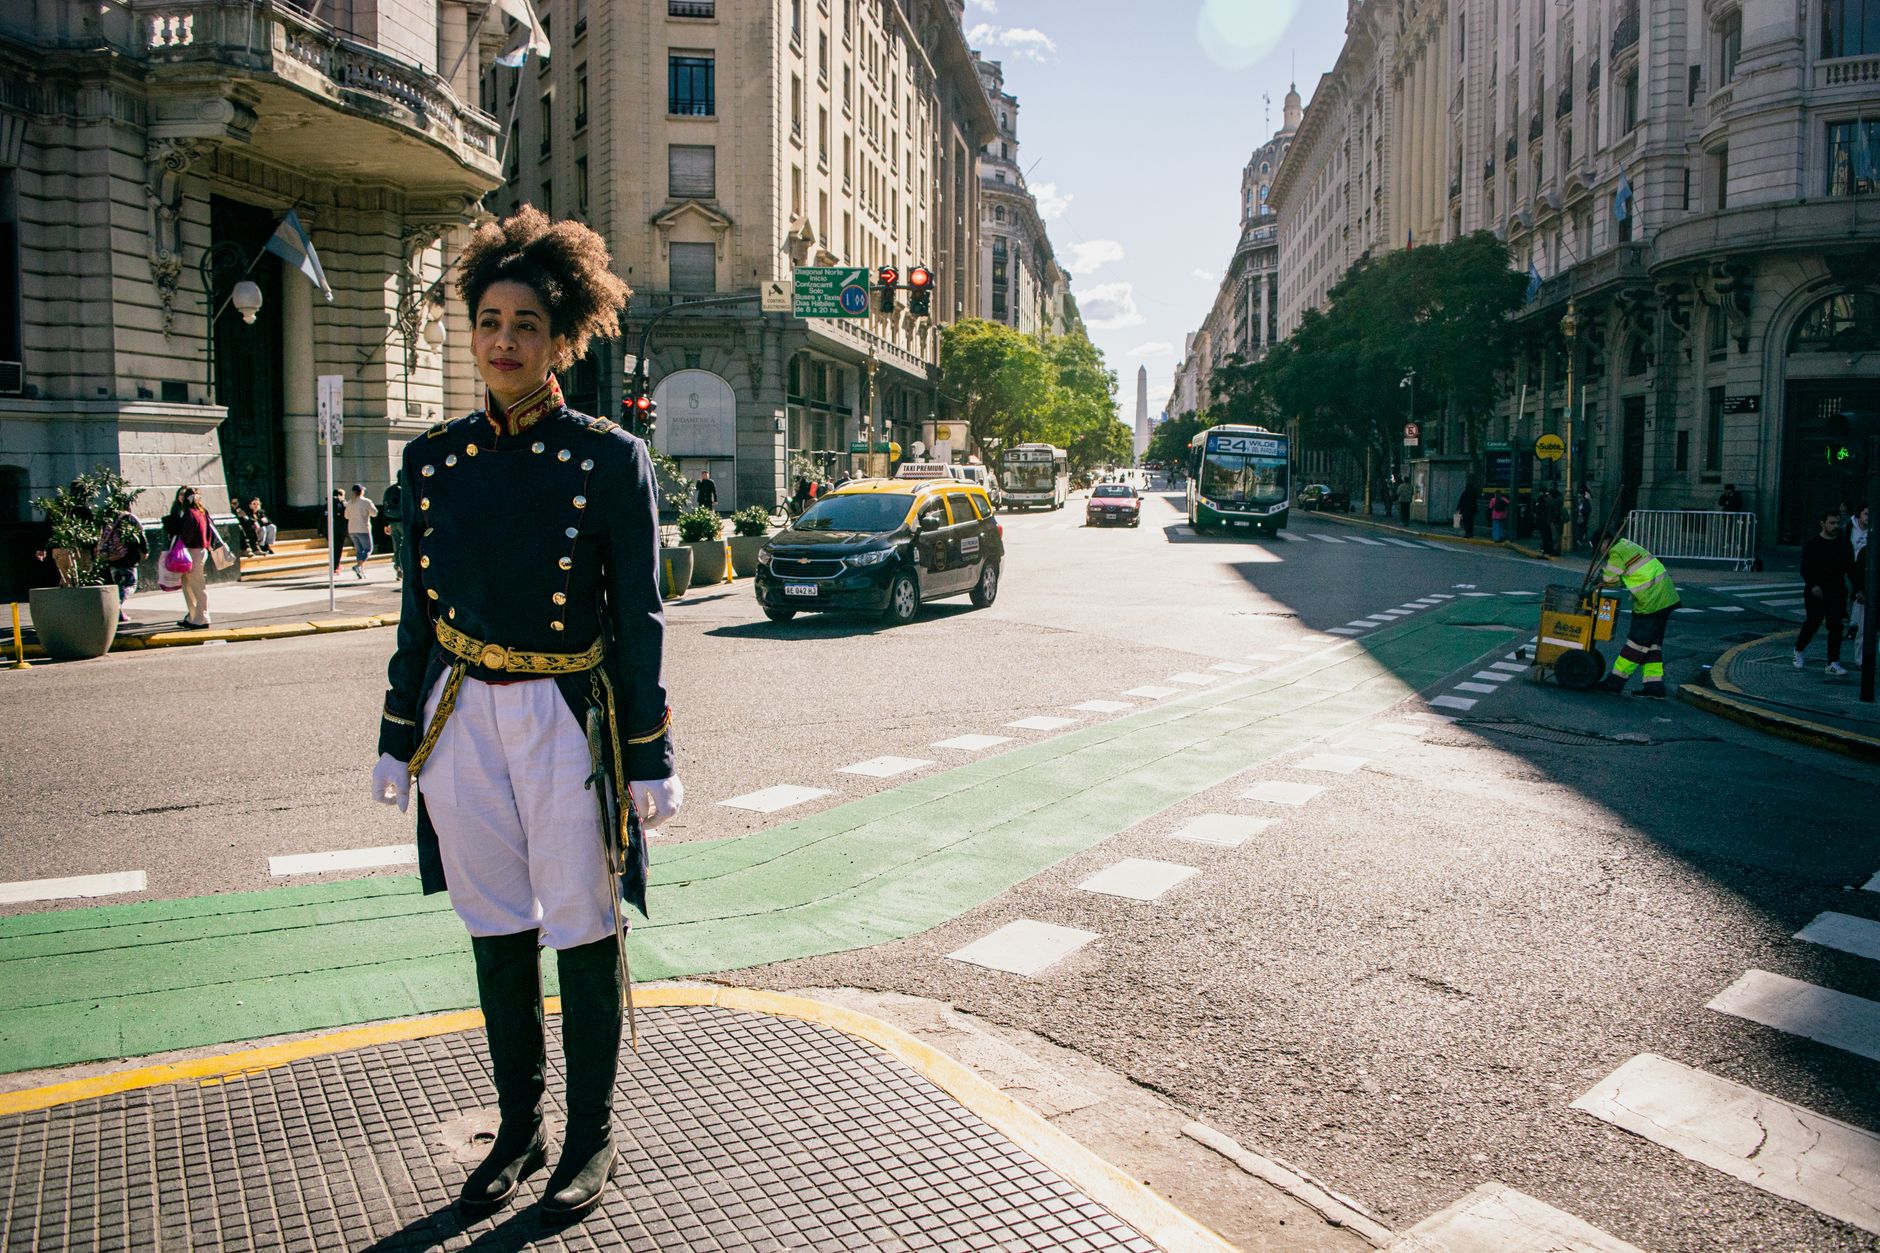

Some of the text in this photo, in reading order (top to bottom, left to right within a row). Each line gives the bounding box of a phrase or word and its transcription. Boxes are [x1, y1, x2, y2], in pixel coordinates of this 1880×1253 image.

[1218, 439, 1247, 452] 24
[1249, 440, 1276, 448] WILDE
[795, 587, 807, 595] 042
[1554, 620, 1582, 634] Aesa
